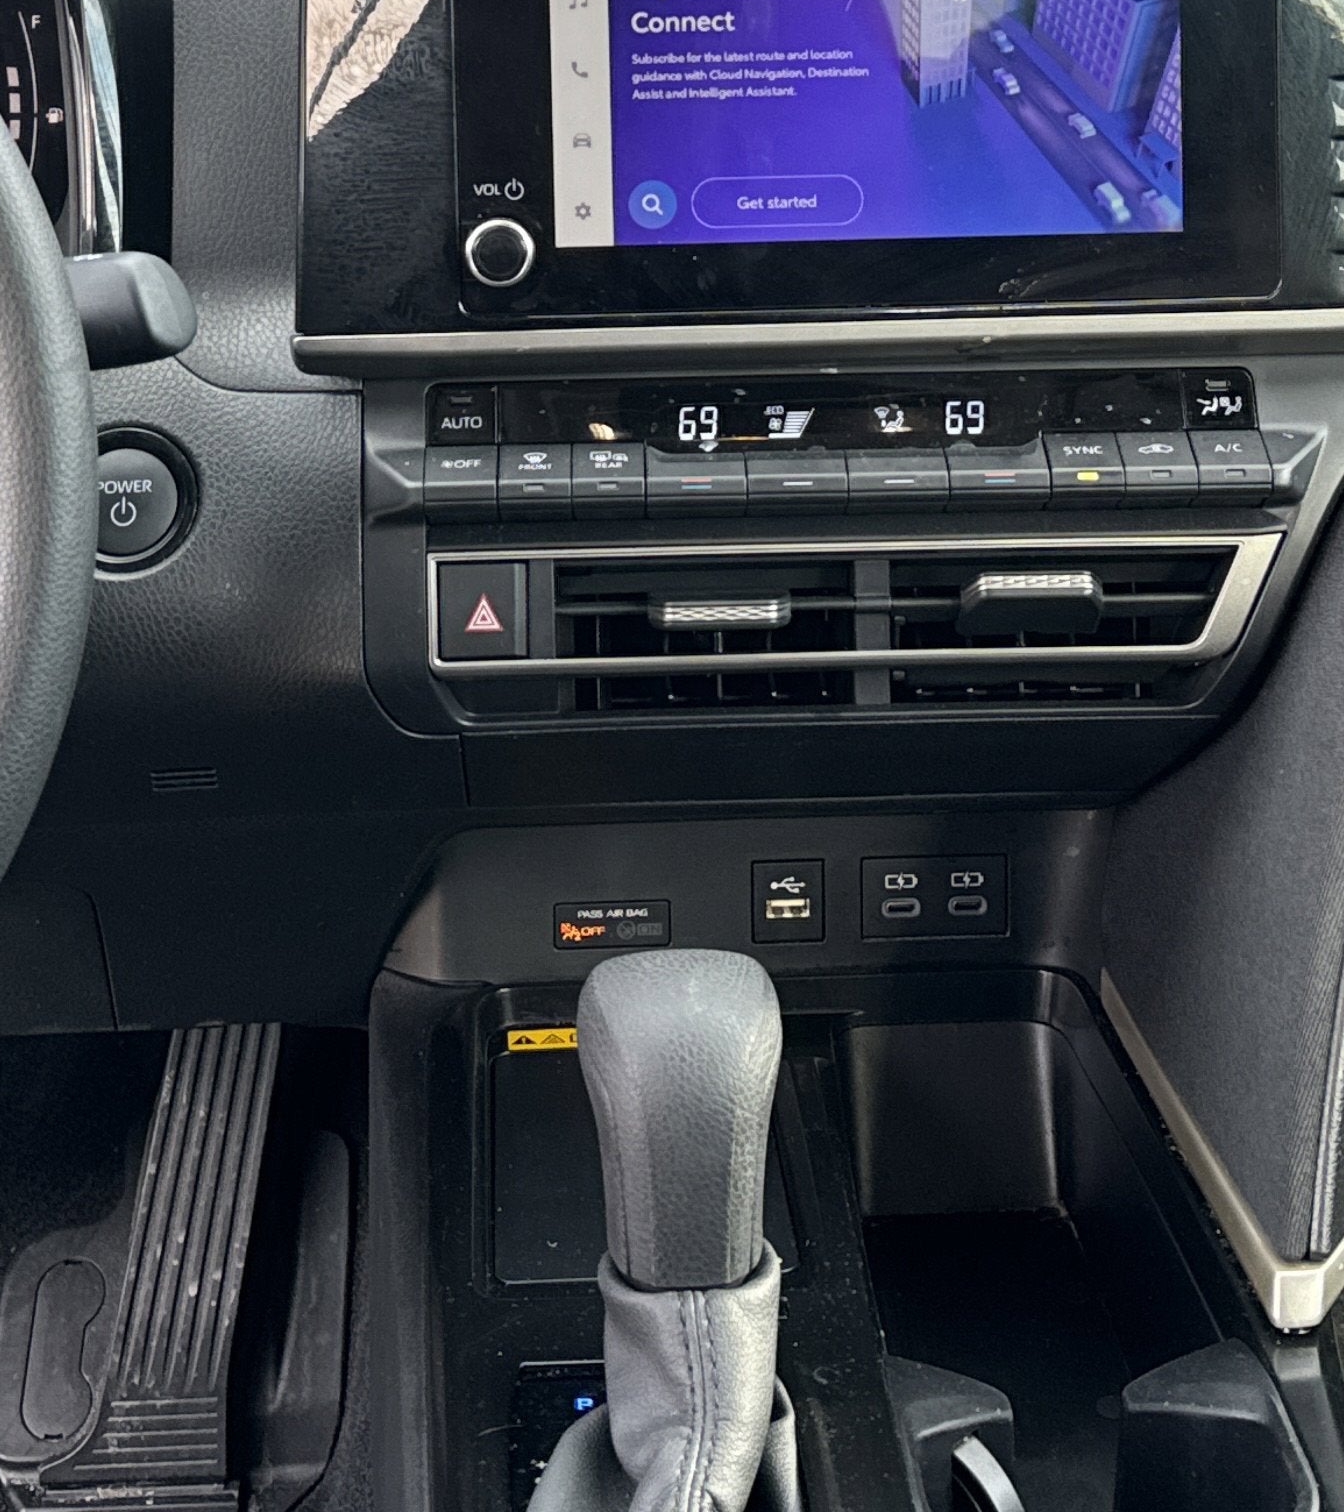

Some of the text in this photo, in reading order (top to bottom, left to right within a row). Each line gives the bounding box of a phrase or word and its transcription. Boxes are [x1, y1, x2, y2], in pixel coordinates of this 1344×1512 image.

[31, 14, 41, 29] F
[630, 11, 736, 34] Connect
[632, 48, 854, 65] Subscribe for the latest route and location
[631, 72, 683, 85] guidance
[684, 70, 708, 81] with
[709, 70, 743, 81] Cloud
[807, 66, 870, 78] Destination
[632, 86, 798, 100] Assist and Intelligent Assistant.
[473, 183, 501, 196] VOL
[736, 193, 817, 210] Get started
[441, 416, 483, 429] AUTO
[678, 405, 718, 441] 69
[945, 400, 985, 435] 69
[1062, 444, 1104, 456] SYNC
[1214, 442, 1244, 454] A/C
[453, 458, 481, 469] OFF
[577, 907, 649, 920] PASS AIR BAG
[580, 925, 606, 937] OFF
[576, 1397, 594, 1411] P
